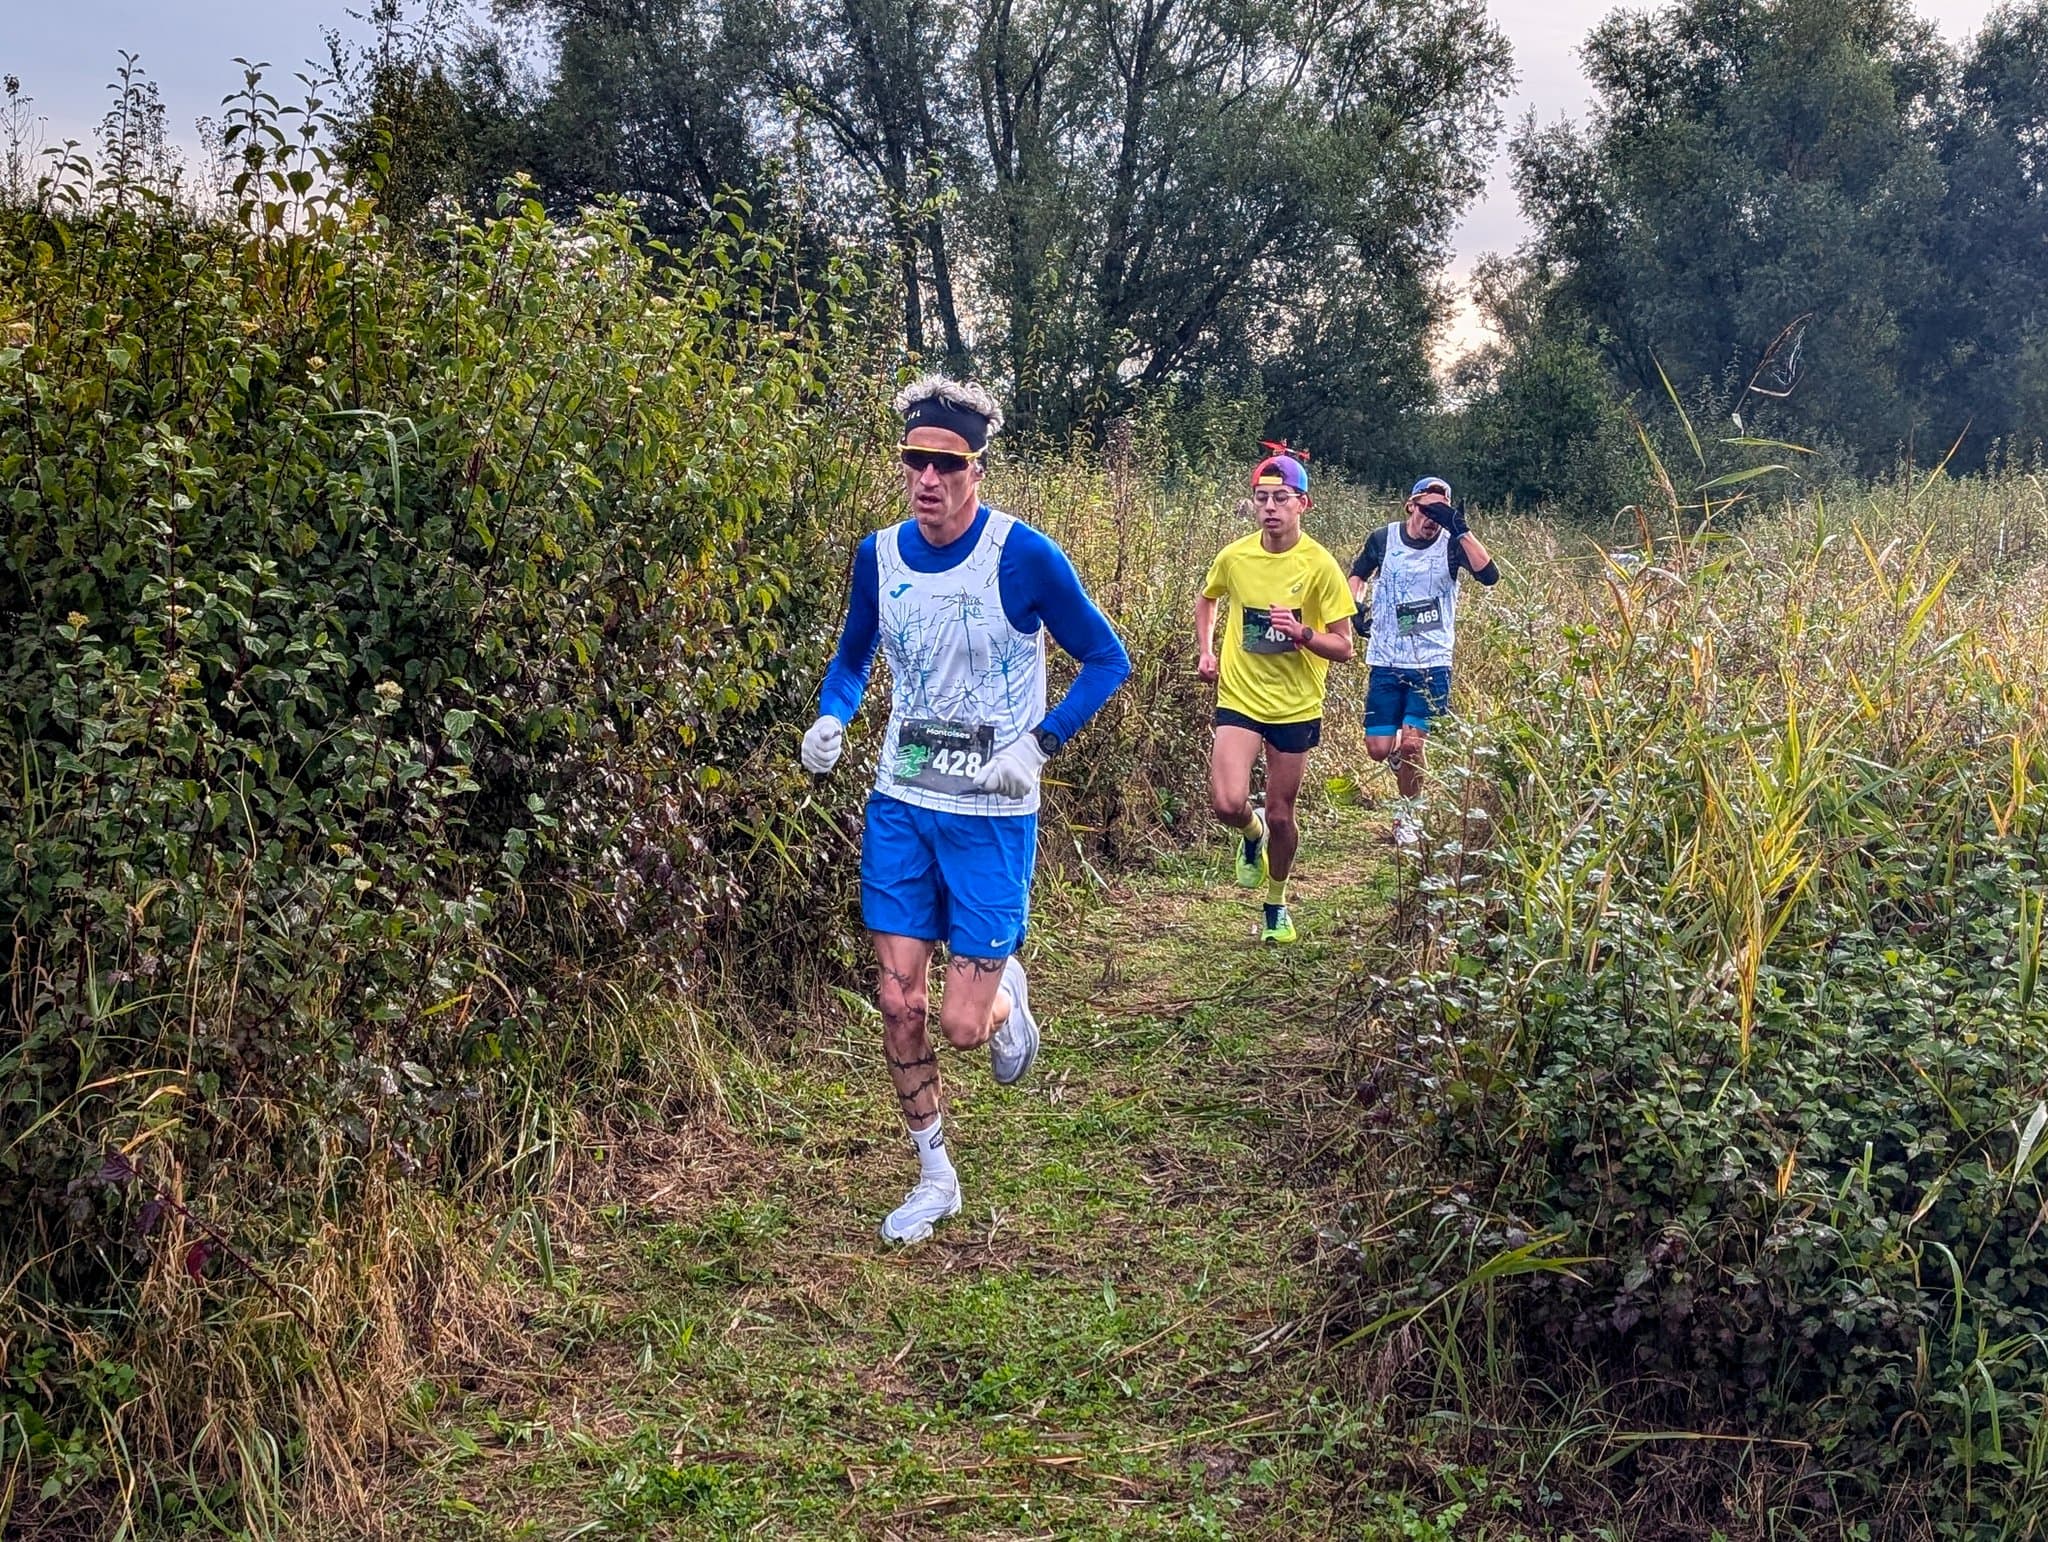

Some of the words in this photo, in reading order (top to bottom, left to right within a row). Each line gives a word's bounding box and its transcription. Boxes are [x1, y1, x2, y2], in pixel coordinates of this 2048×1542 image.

[1417, 609, 1439, 625] 469
[1265, 626, 1293, 642] 46
[932, 748, 982, 778] 428
